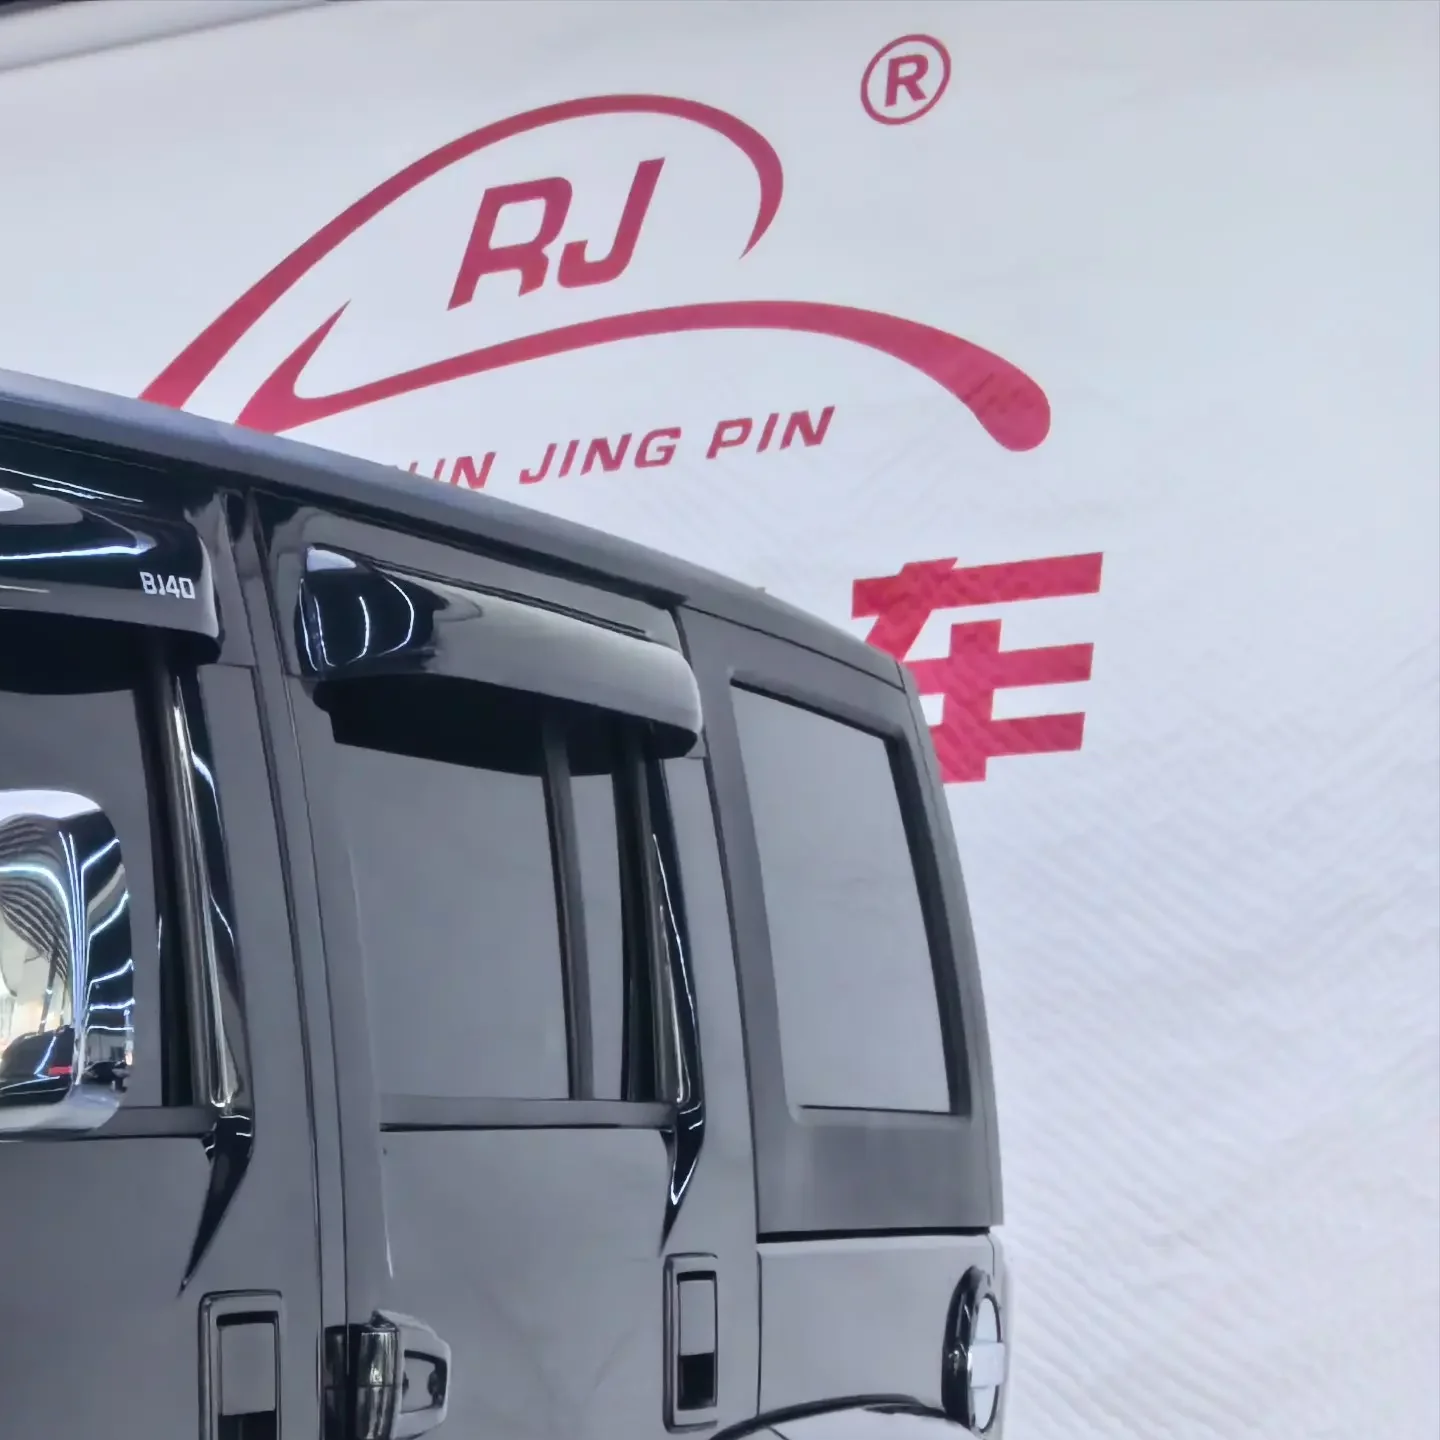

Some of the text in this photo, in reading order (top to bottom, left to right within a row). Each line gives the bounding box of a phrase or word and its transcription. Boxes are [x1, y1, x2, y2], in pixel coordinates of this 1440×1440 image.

[447, 157, 665, 310] RJ
[519, 426, 682, 485] JING
[705, 405, 836, 460] PIN
[140, 571, 196, 599] BJ40
